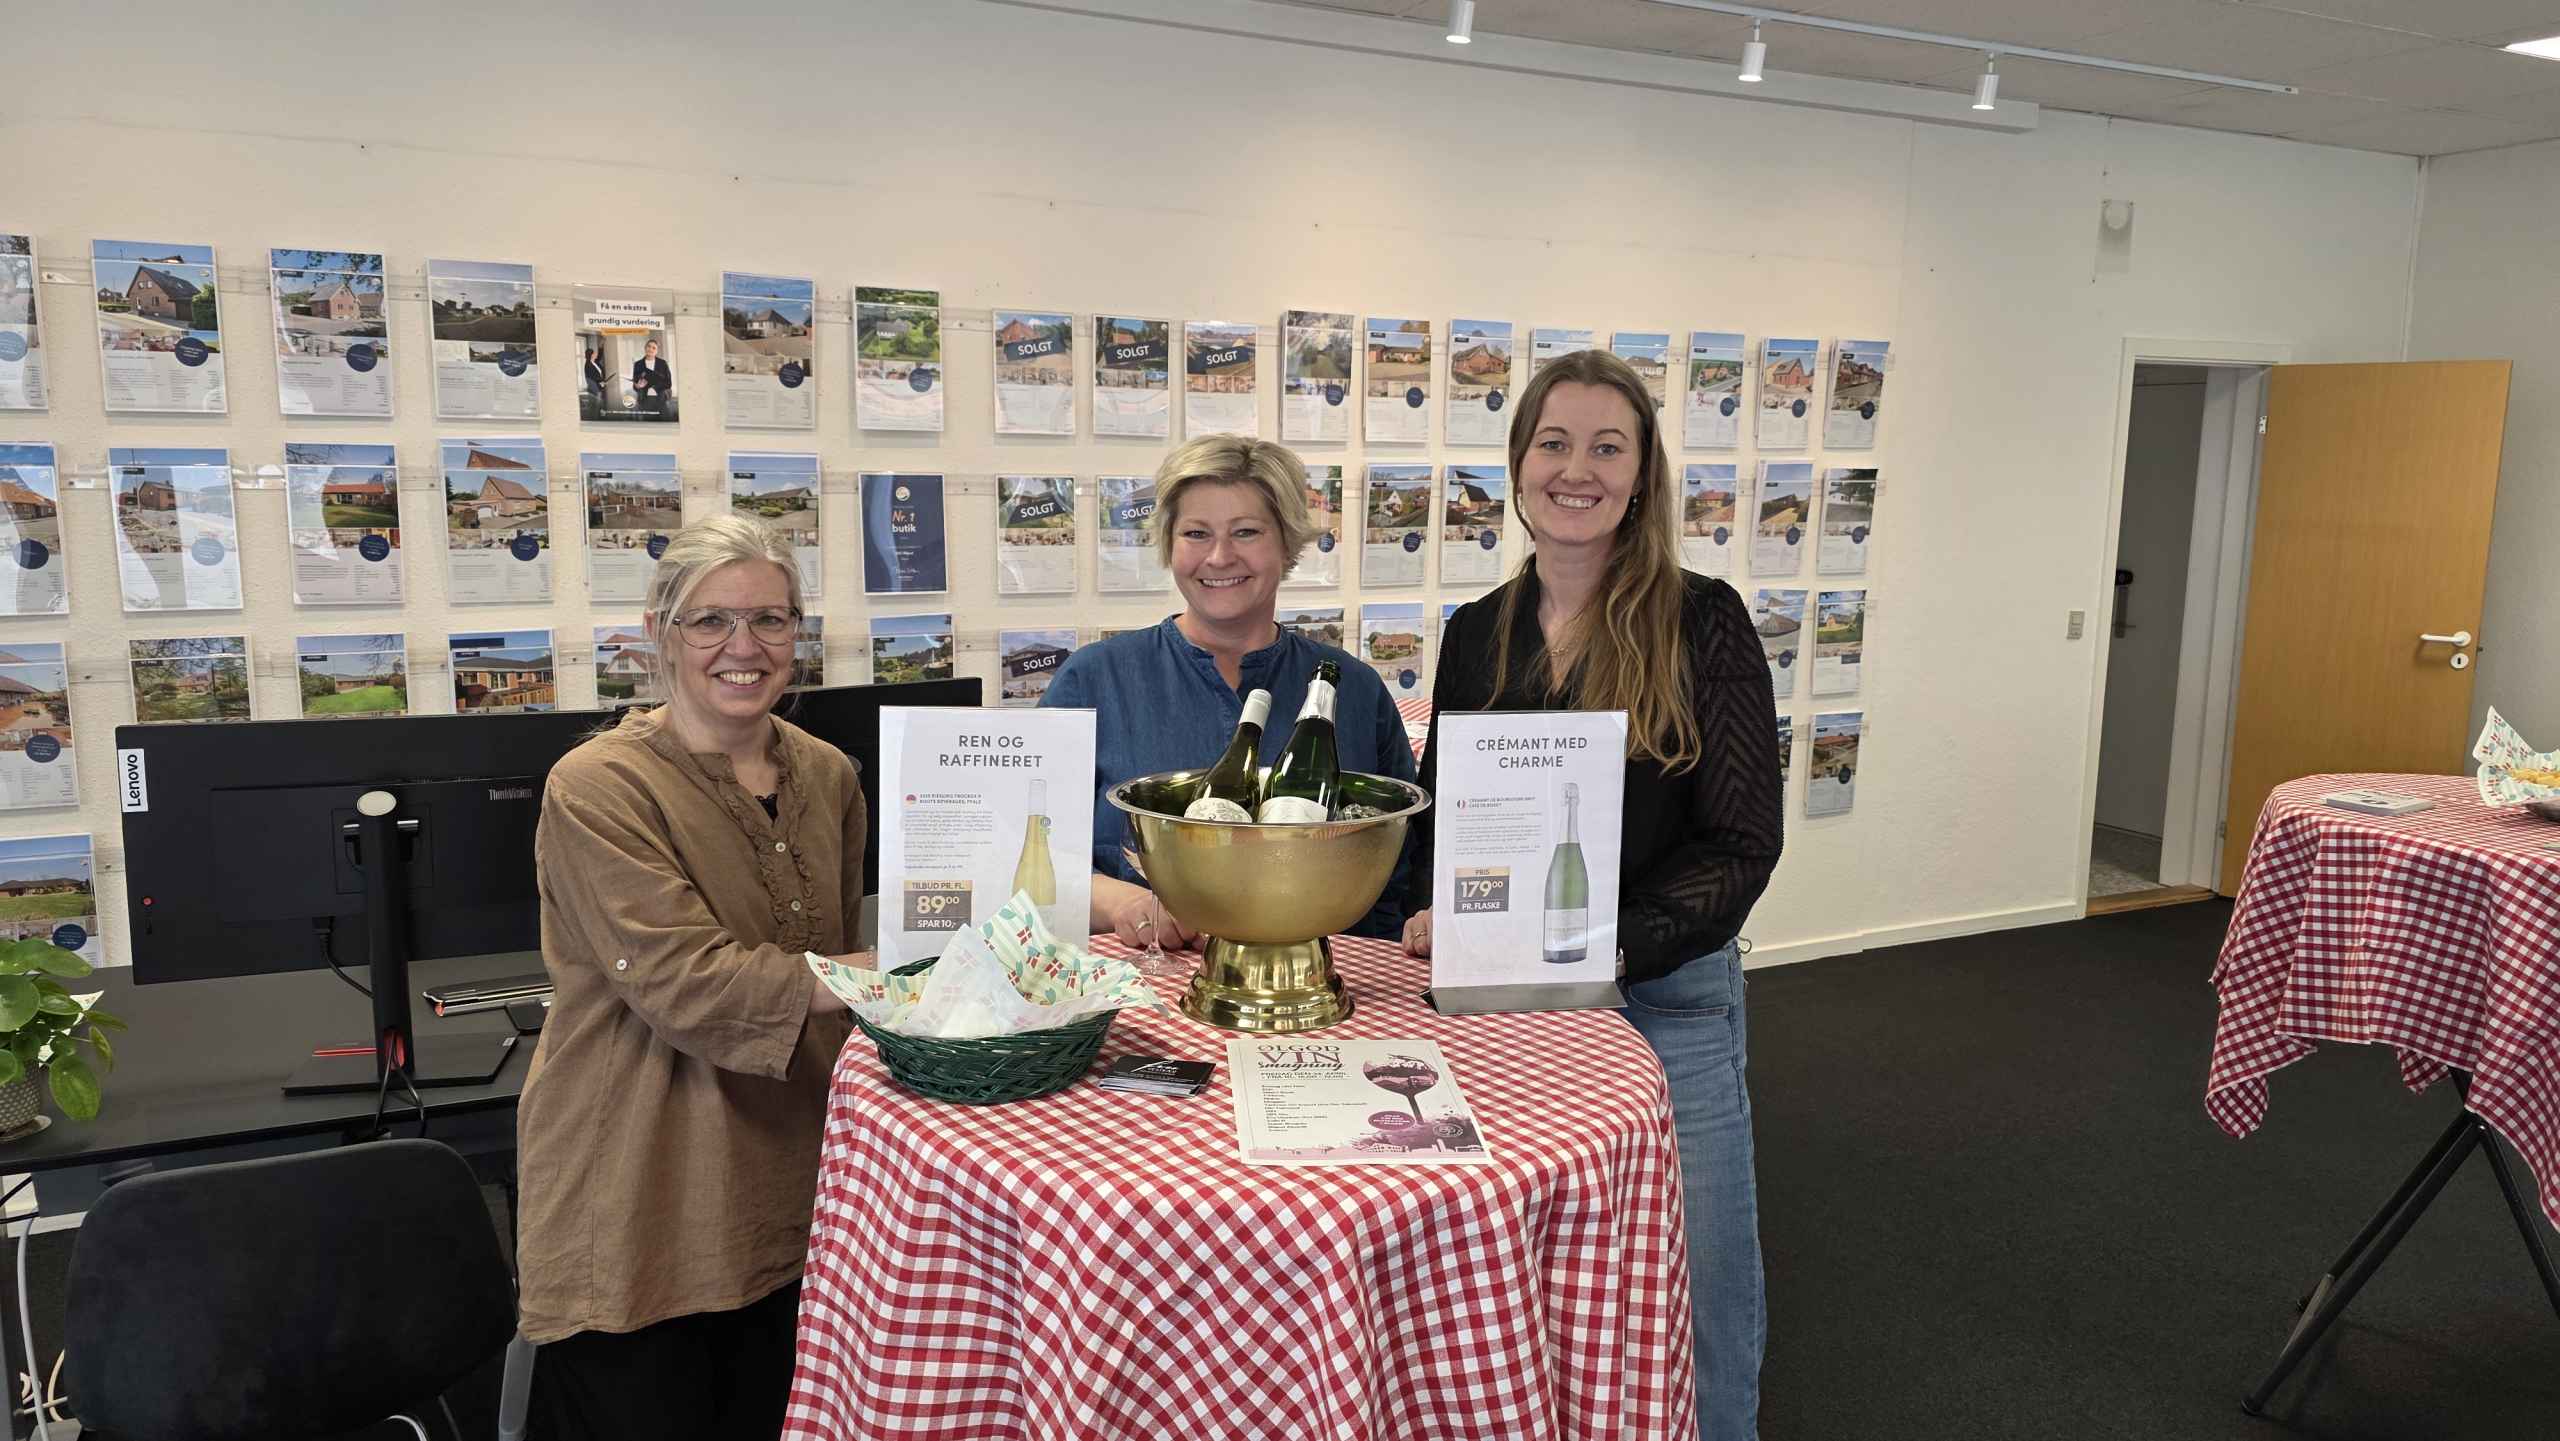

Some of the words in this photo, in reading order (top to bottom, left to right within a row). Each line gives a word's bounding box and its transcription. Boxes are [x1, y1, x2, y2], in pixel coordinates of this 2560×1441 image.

[600, 302, 610, 310] Få
[623, 303, 647, 311] ekstra
[588, 317, 621, 326] grundig
[621, 319, 661, 328] vurdering
[1017, 340, 1053, 356] SOLGT
[1116, 345, 1150, 360] SOLGT
[1206, 350, 1238, 366] SOLGT
[892, 511, 907, 522] Nr.
[1020, 502, 1055, 518] SOLGT
[1121, 504, 1154, 520] SOLGT
[892, 524, 916, 533] butik
[1023, 655, 1057, 671] SOLGT
[958, 735, 992, 748] REN
[998, 736, 1025, 748] OG
[1476, 735, 1551, 751] CRÉMANT
[1554, 737, 1588, 749] MED
[938, 754, 1043, 768] RAFFINERET
[1498, 755, 1564, 769] CHARME
[127, 754, 141, 807] Lenovo
[911, 881, 939, 889] TILBUD
[955, 882, 965, 890] FL.
[1461, 902, 1473, 911] PR.
[1474, 901, 1500, 911] FLASKE
[917, 919, 941, 928] SPAR
[1256, 1051, 1342, 1064] VIN
